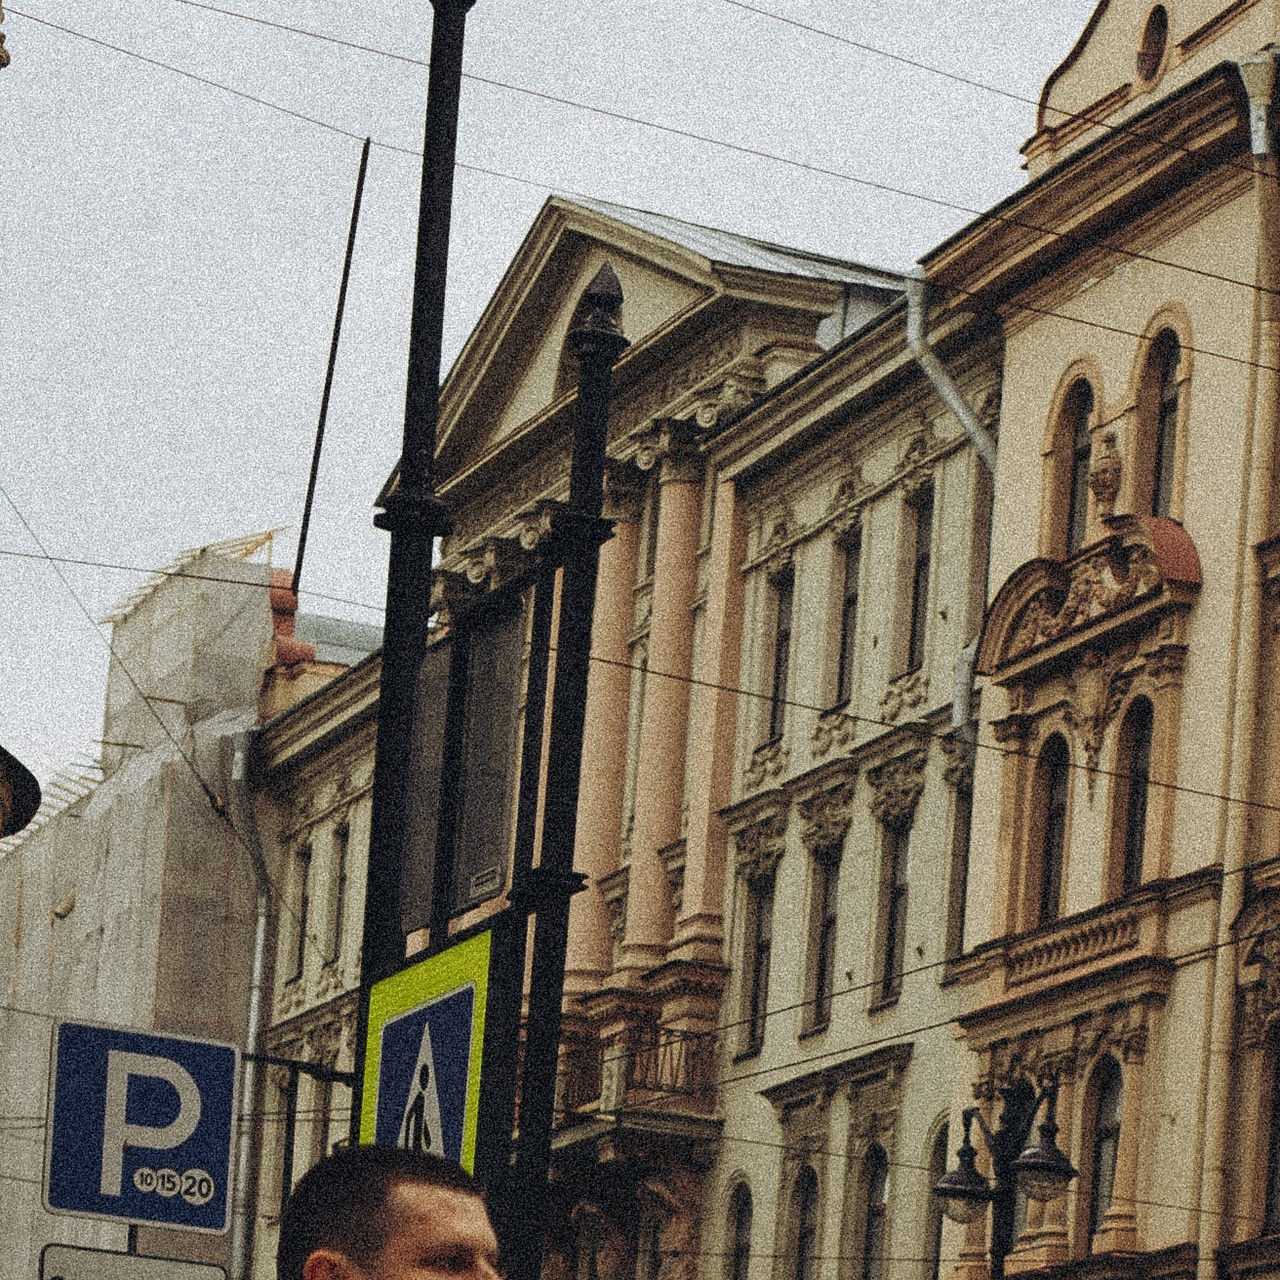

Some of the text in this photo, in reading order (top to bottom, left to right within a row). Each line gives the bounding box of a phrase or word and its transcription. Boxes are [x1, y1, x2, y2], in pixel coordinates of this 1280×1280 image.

[101, 1050, 201, 1197] P
[139, 1172, 212, 1198] 10 15 20
